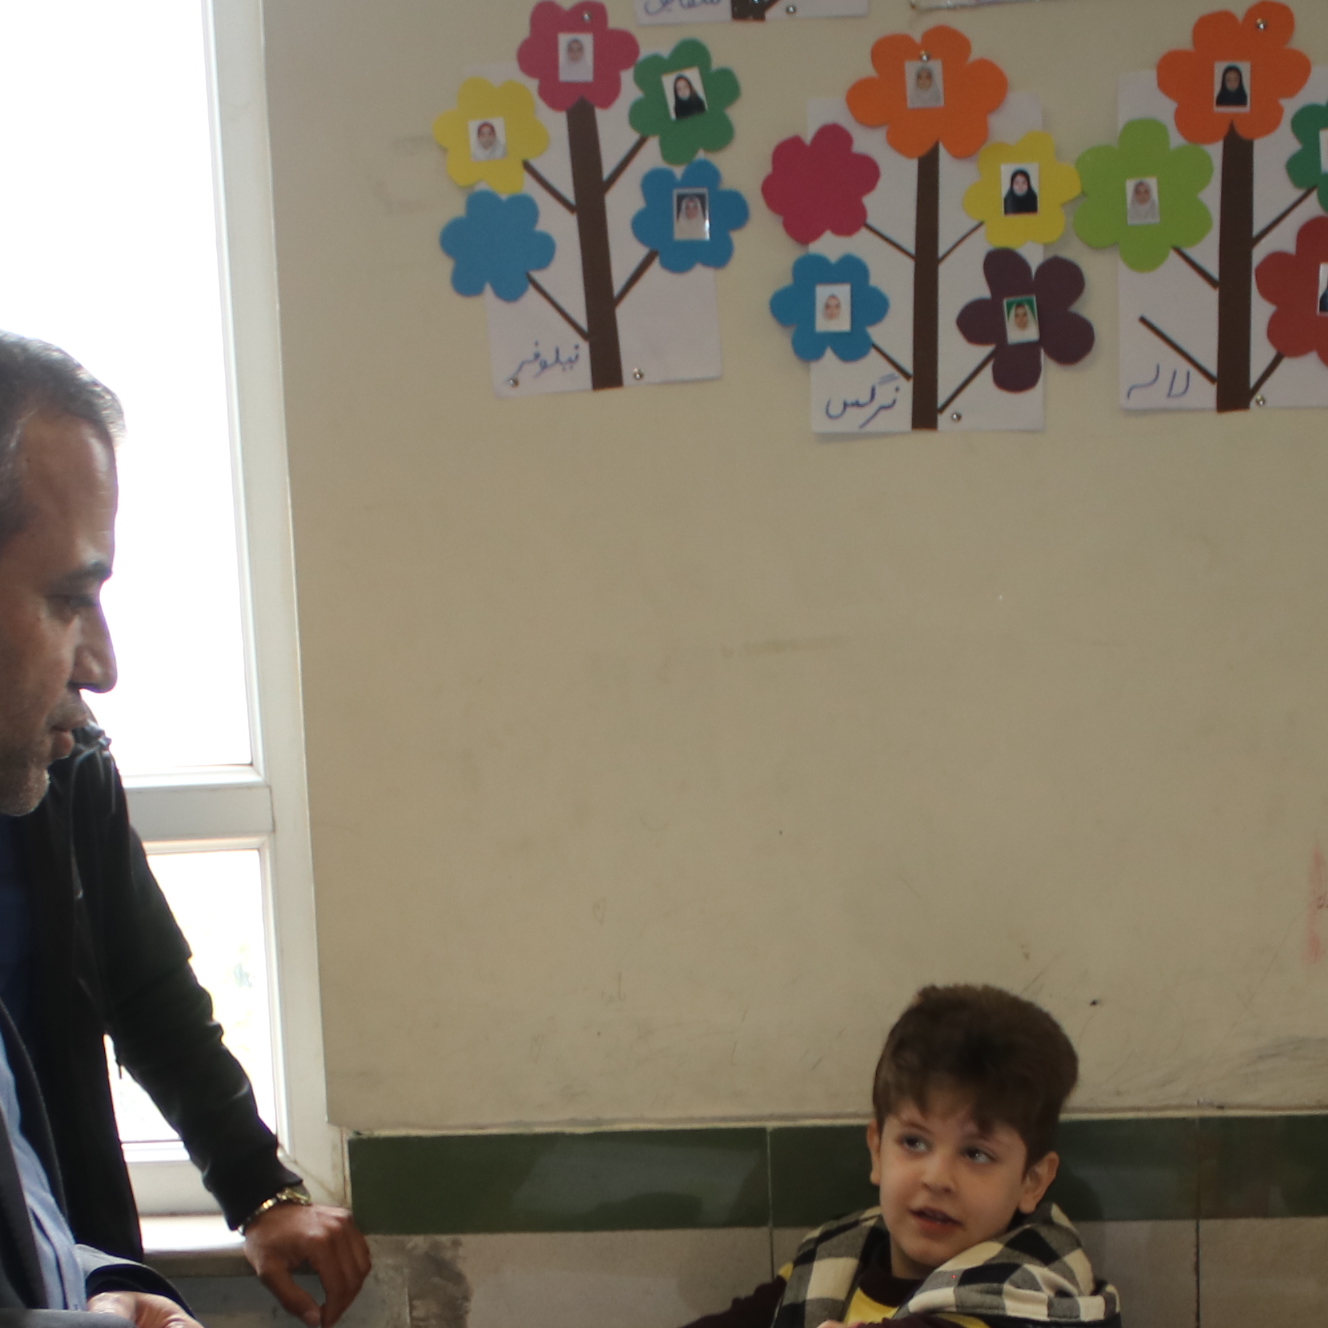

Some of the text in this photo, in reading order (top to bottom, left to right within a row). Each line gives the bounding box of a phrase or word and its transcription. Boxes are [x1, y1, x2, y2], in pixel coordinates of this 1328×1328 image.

[507, 340, 580, 380] نیلوفر
[825, 373, 900, 430] نرگس
[1126, 363, 1190, 400] لاله
